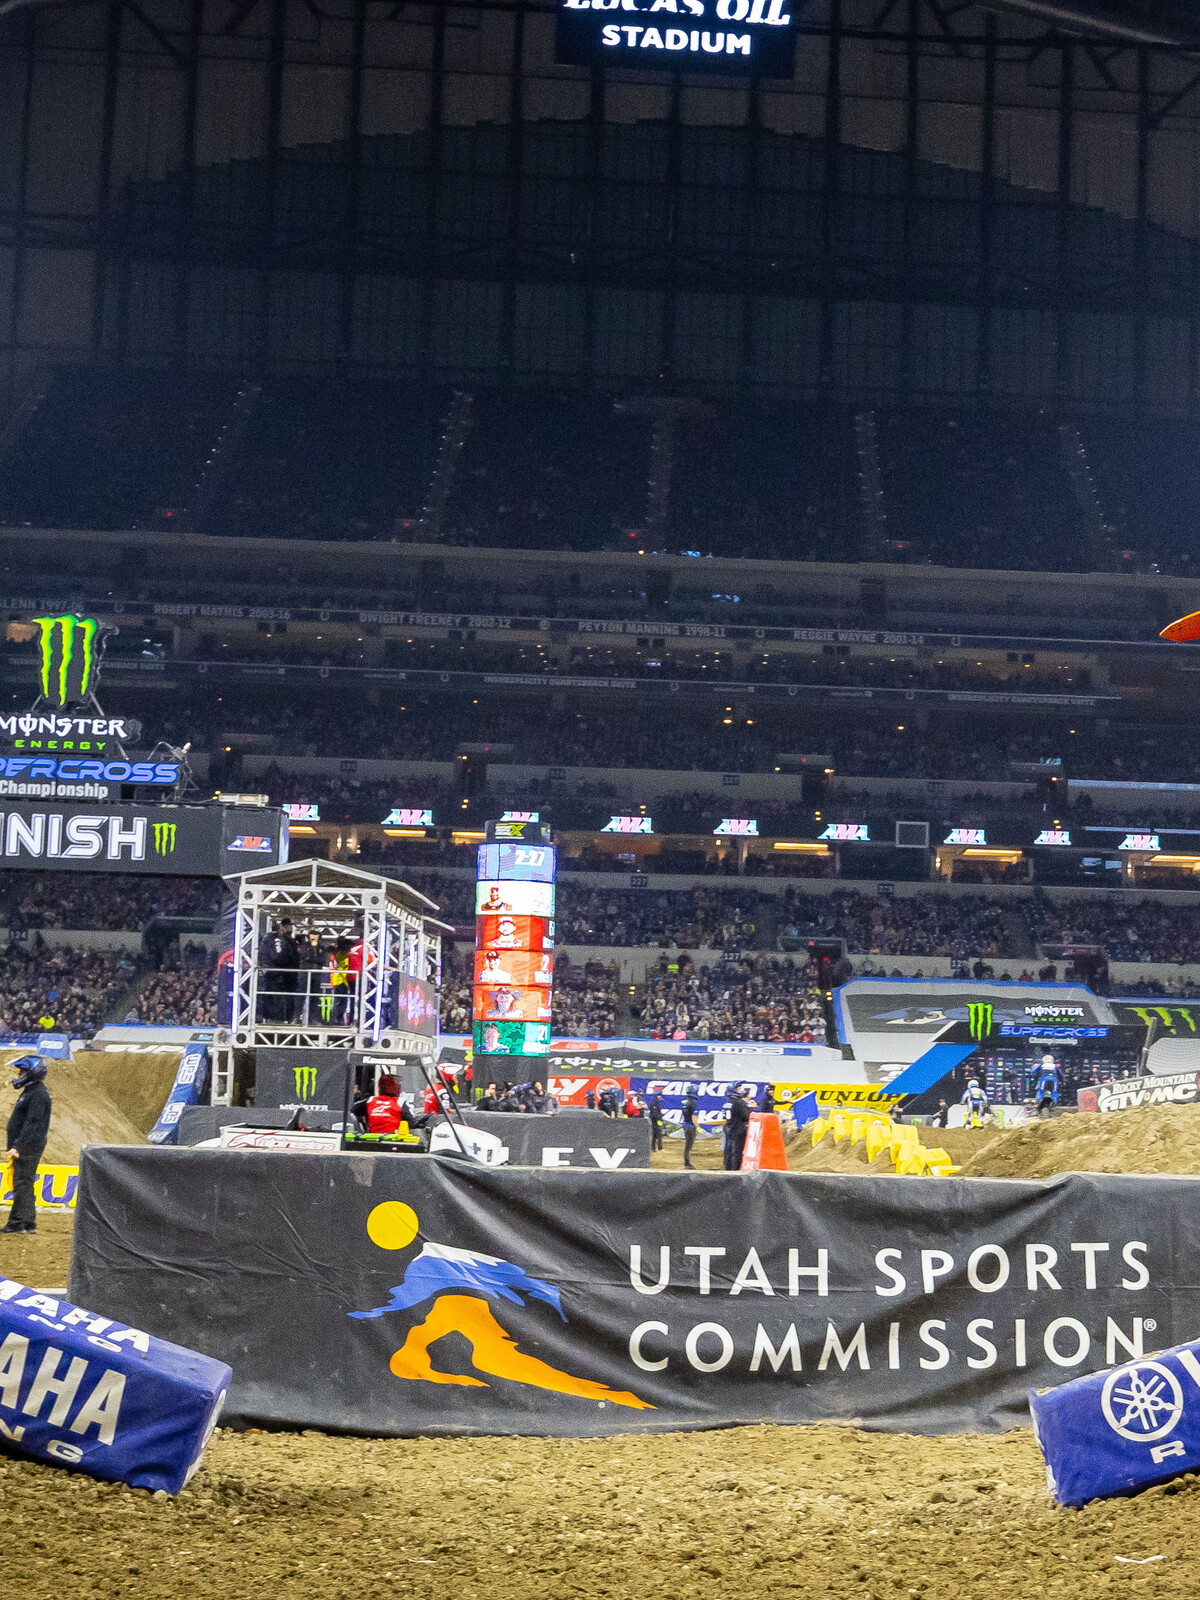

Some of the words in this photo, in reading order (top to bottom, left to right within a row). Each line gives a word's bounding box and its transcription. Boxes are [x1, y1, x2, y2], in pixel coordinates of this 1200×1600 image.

[602, 25, 751, 54] STADIUM
[154, 605, 197, 616] ROBERT
[201, 607, 244, 618] MATHIS
[360, 613, 404, 624] DWIGHT
[409, 615, 461, 626] FREENEY
[578, 622, 623, 633] PEYTON
[626, 624, 680, 635] MANNING
[793, 631, 834, 641] REGGIE
[838, 633, 877, 643] WAYNE
[15, 739, 106, 751] ENERGY
[0, 757, 180, 783] ERCROSS
[0, 782, 108, 799] Championship
[381, 809, 434, 826] AMA
[601, 817, 654, 833] AMA
[713, 819, 759, 835] AMA
[817, 824, 870, 841] AMA
[0, 812, 147, 860] NISH
[943, 828, 987, 845] AMA
[1118, 835, 1161, 851] AMA
[1025, 1005, 1084, 1016] MONSTER
[999, 1026, 1109, 1037] SUPERCROSS
[549, 1057, 702, 1069] MONSTER
[1112, 1081, 1142, 1095] ROCKY
[1143, 1073, 1197, 1088] MOUNTAIN
[805, 1090, 901, 1102] UNLOP
[629, 1244, 829, 1297] UTAH
[874, 1240, 1150, 1294] SPORTS
